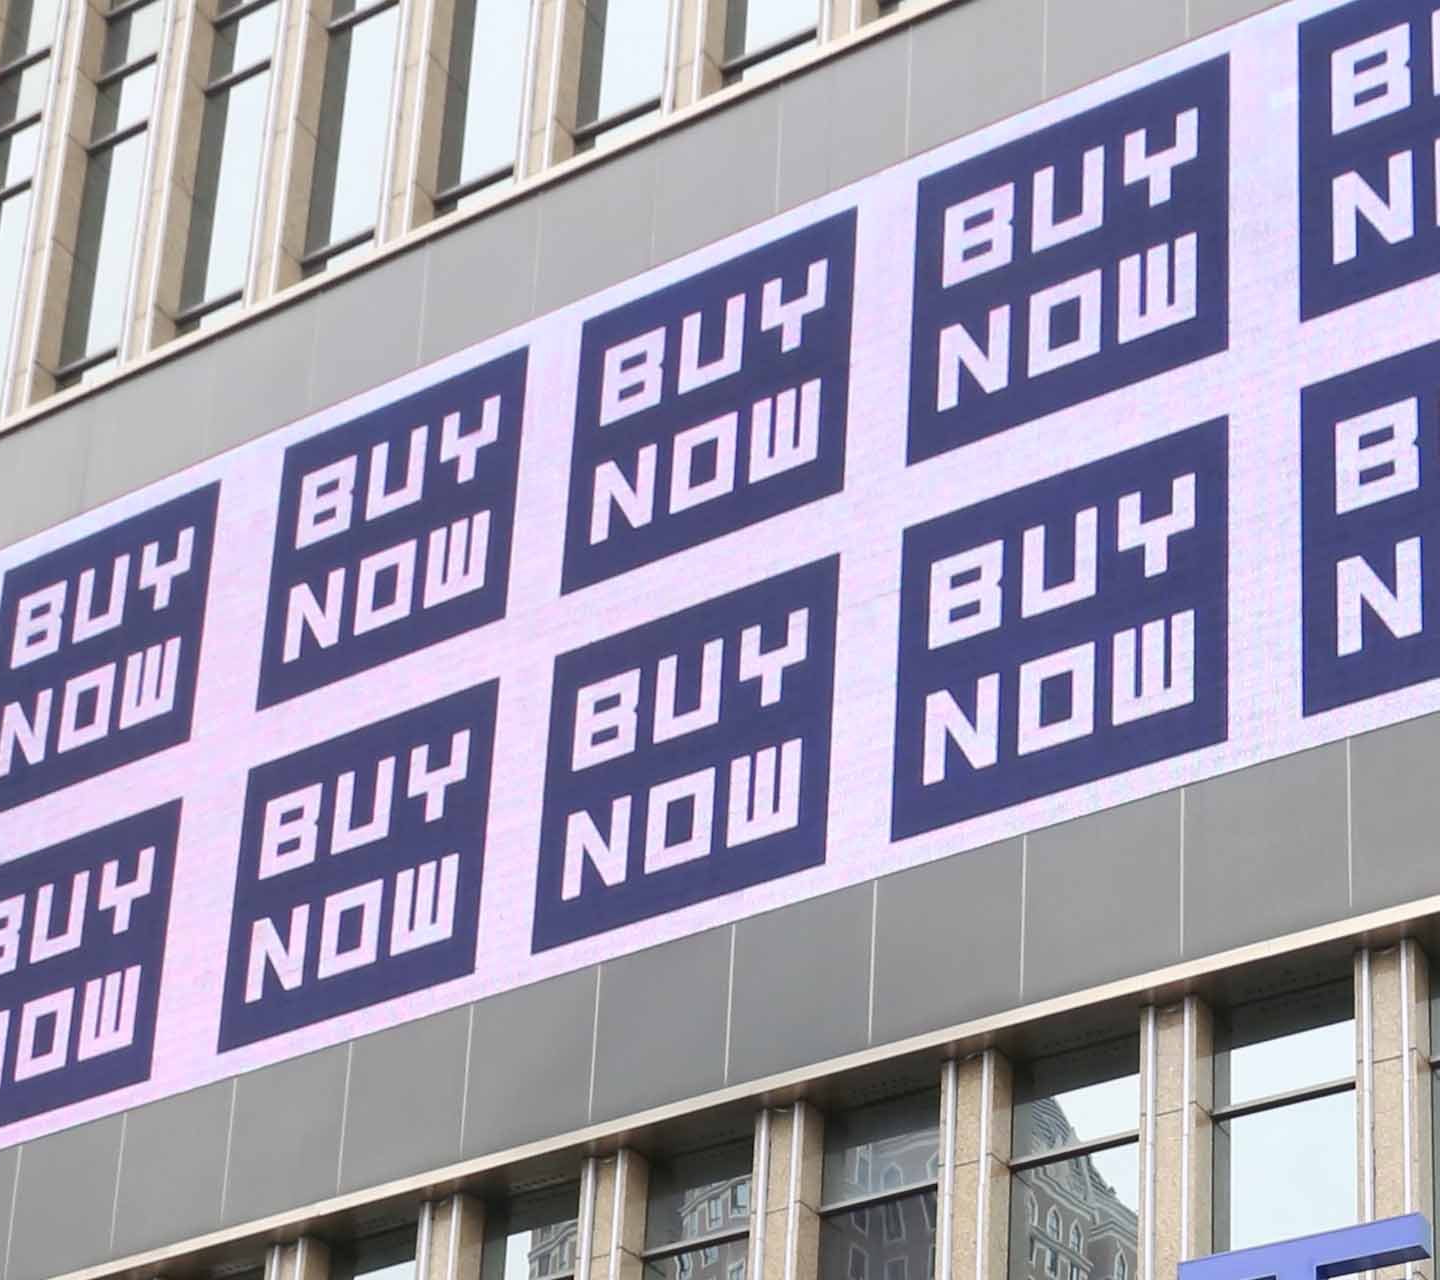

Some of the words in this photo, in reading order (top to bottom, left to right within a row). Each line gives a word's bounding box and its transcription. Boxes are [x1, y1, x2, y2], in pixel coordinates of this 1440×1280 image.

[942, 108, 1198, 288] BUY
[600, 259, 828, 426] BUY
[937, 232, 1197, 412] NOW
[295, 395, 501, 549] BUY
[590, 378, 821, 545] NOW
[10, 526, 194, 669] BUY
[283, 510, 490, 663] NOW
[928, 473, 1195, 649] BUY
[572, 608, 808, 771] BUY
[923, 610, 1194, 785] NOW
[259, 730, 470, 880] BUY
[562, 738, 802, 900] NOW
[245, 853, 459, 1003] NOW
